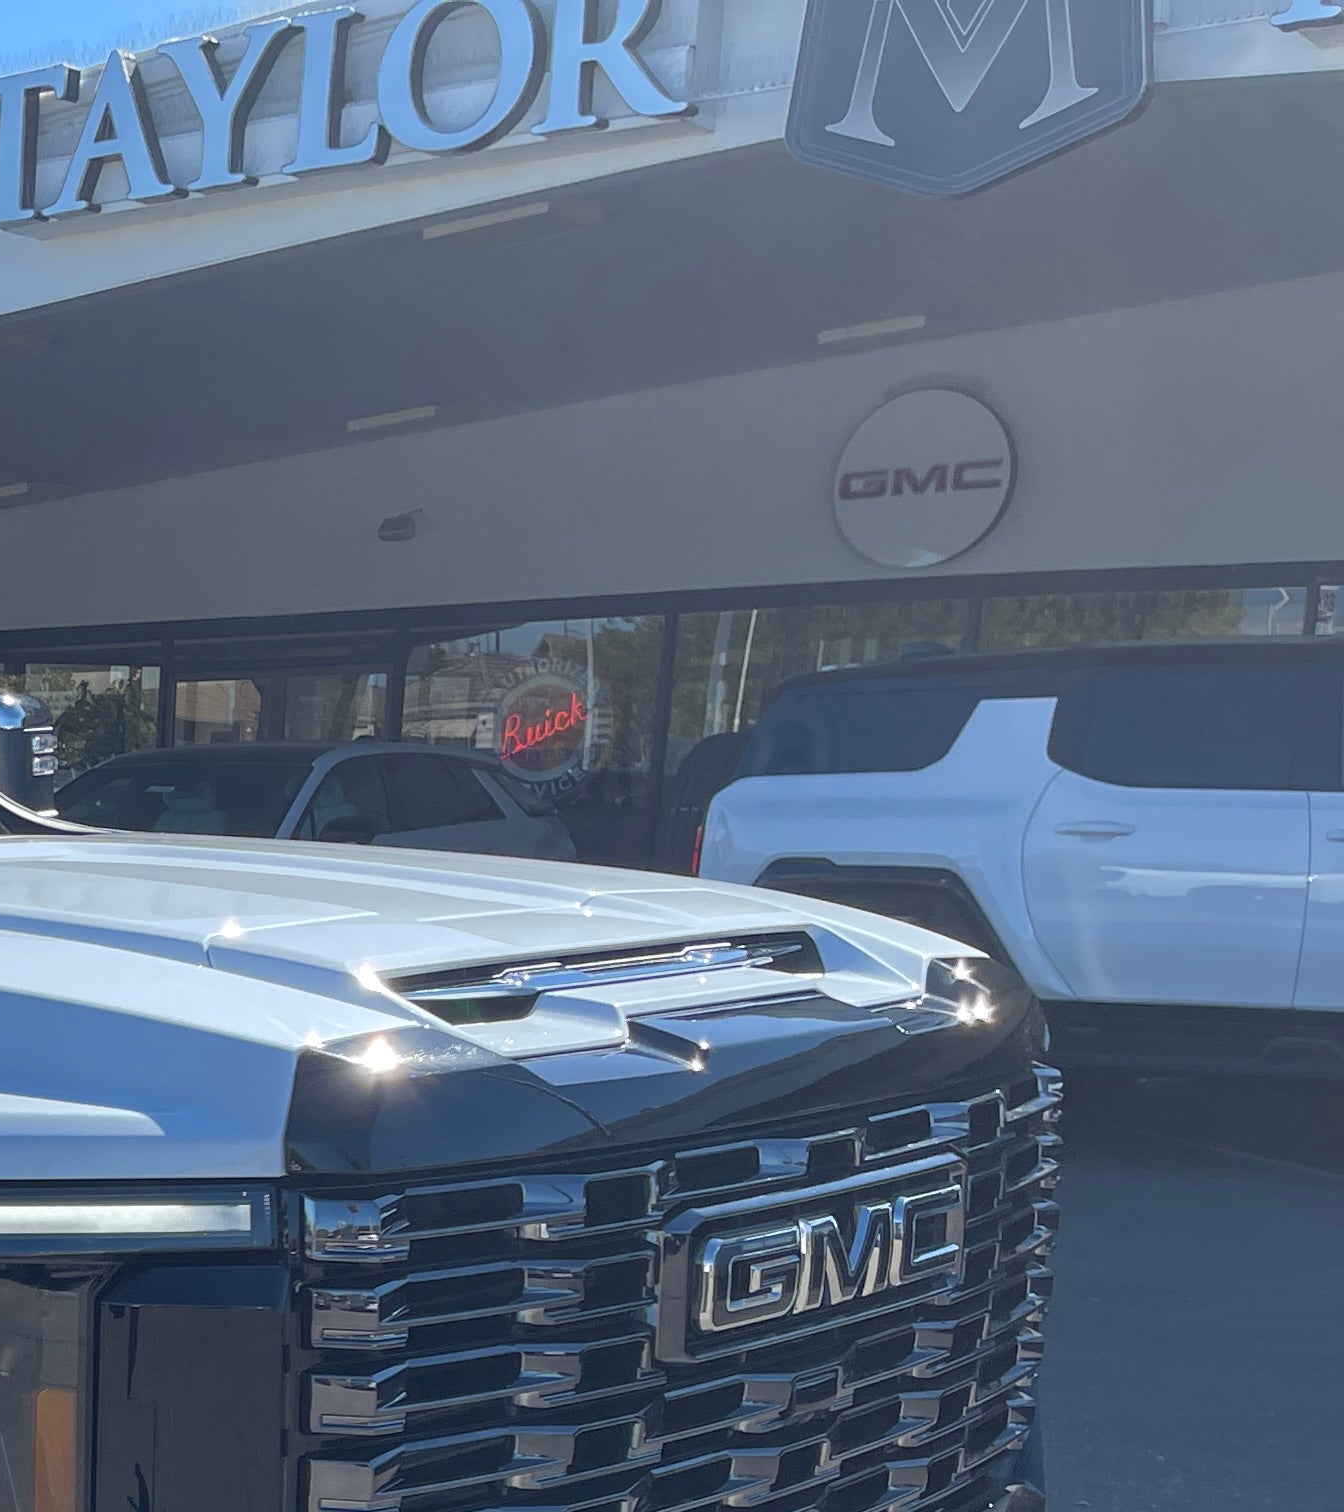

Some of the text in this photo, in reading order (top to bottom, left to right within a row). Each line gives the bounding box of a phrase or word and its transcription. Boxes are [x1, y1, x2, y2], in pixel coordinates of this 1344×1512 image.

[839, 458, 1004, 500] GMC
[499, 691, 590, 762] Buick
[699, 1183, 962, 1332] GMC
